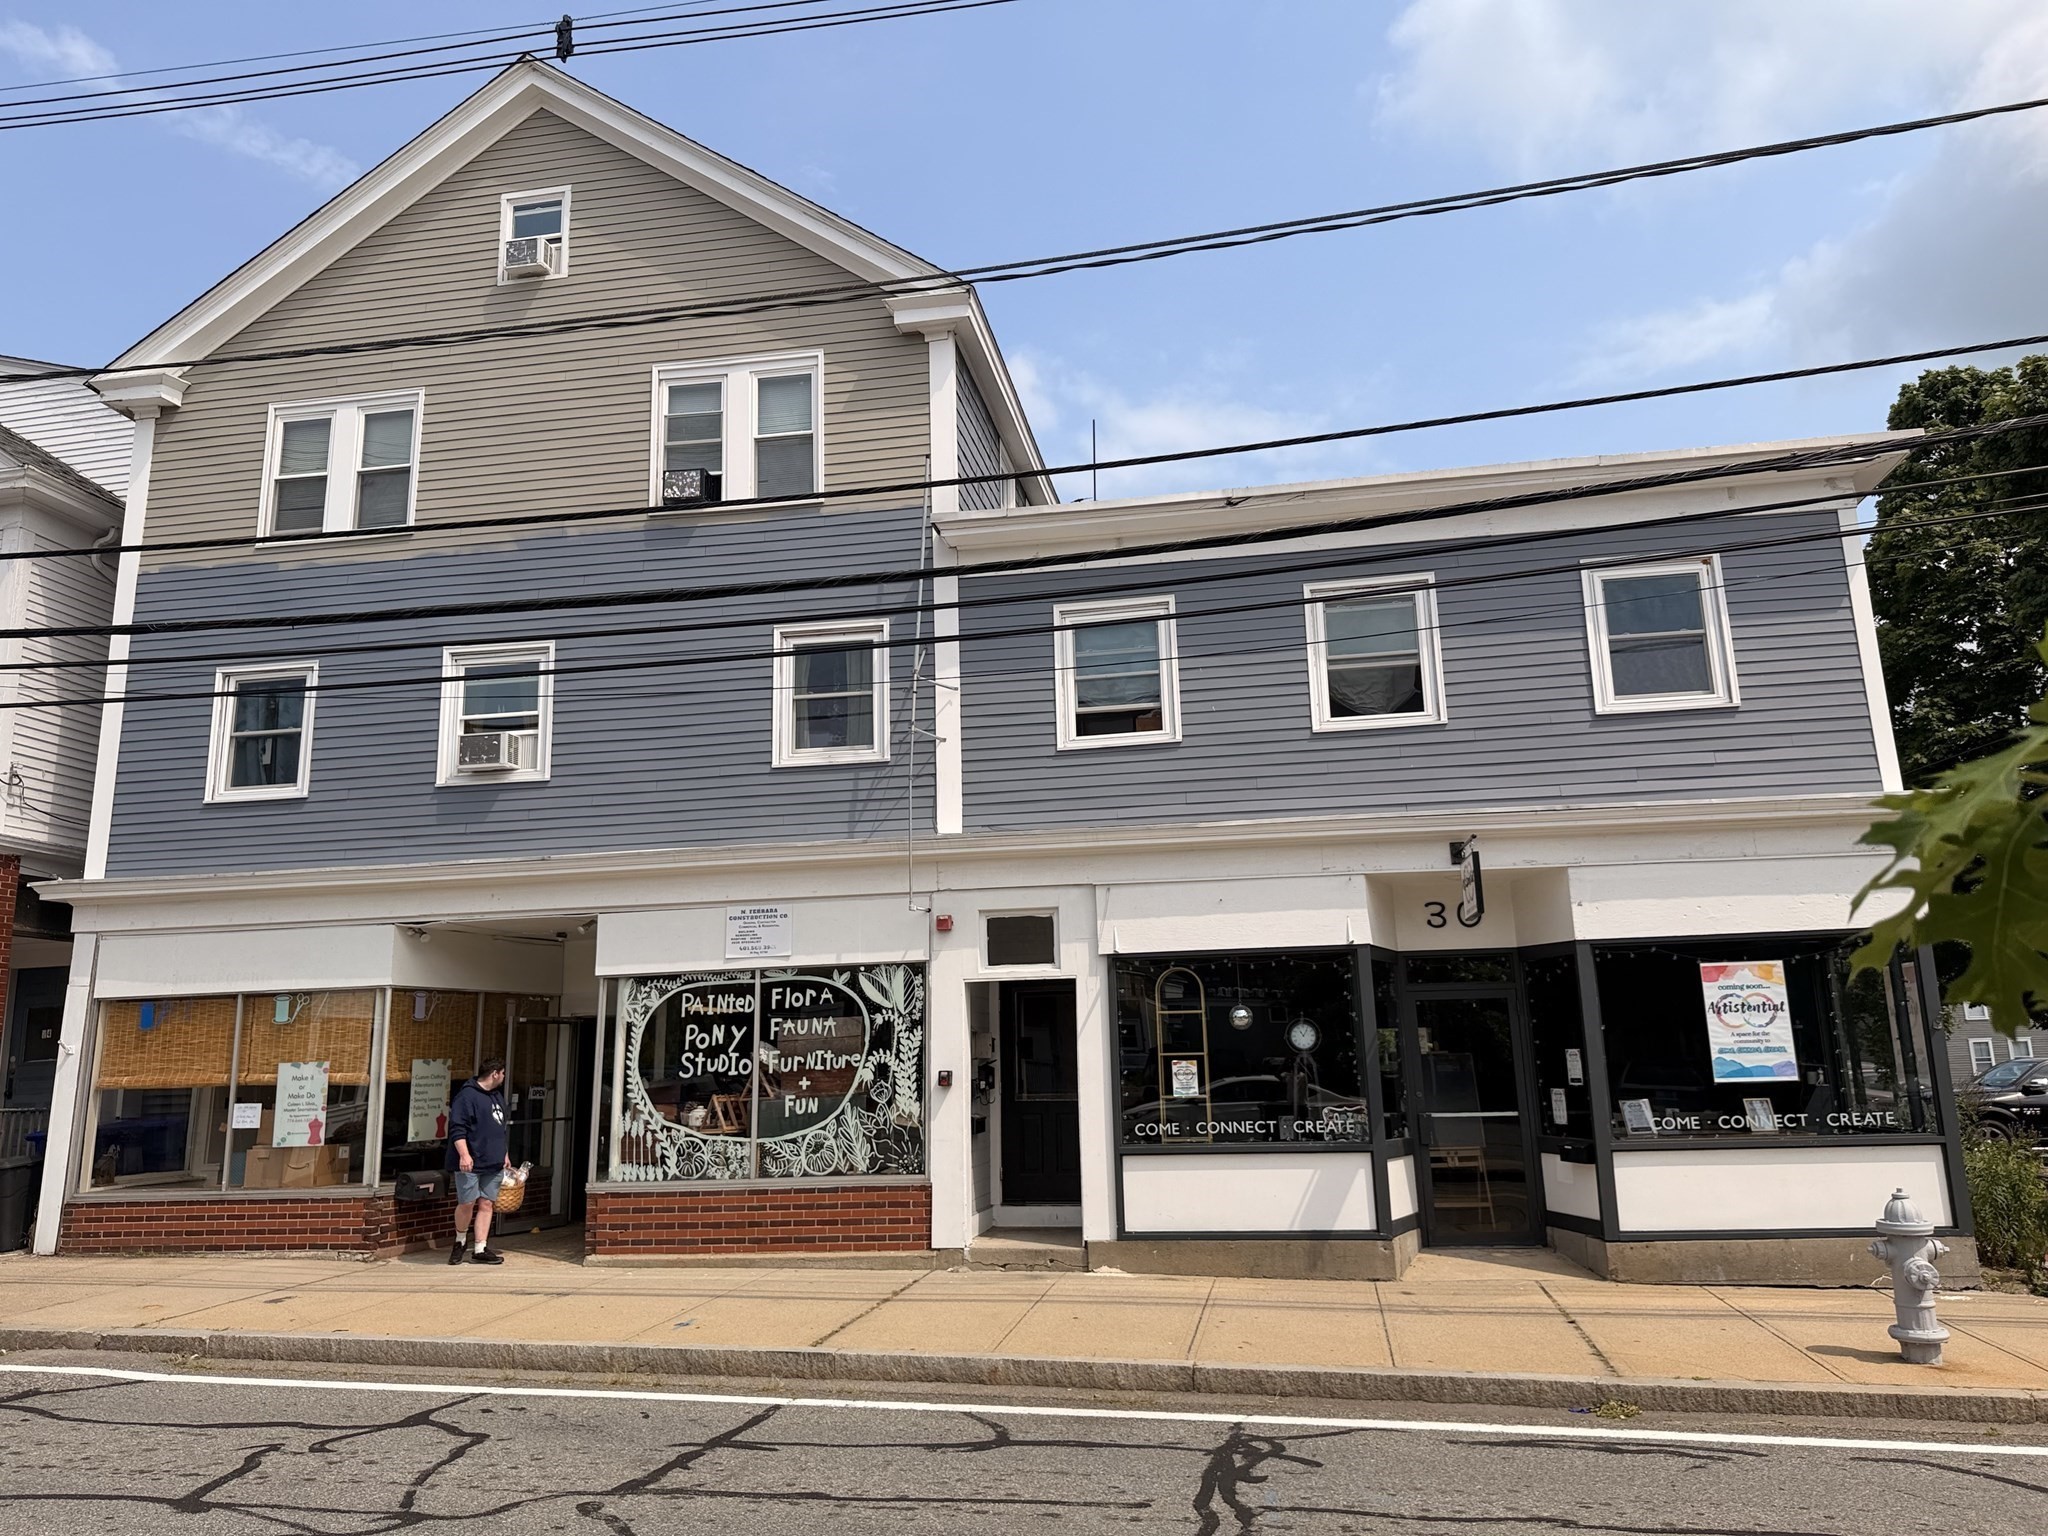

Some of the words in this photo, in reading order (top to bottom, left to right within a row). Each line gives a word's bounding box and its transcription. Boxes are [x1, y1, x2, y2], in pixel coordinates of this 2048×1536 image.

[1424, 901, 1482, 928] 30
[1708, 1001, 1786, 1014] Artistential
[770, 1016, 836, 1040] FAUNA
[1134, 1122, 1180, 1136] COME
[1195, 1120, 1276, 1134] CONNECT
[1293, 1118, 1354, 1133] CREATE
[1651, 1116, 1700, 1130] COME
[1718, 1113, 1808, 1130] CONNECT
[1826, 1112, 1895, 1126] CREATE
